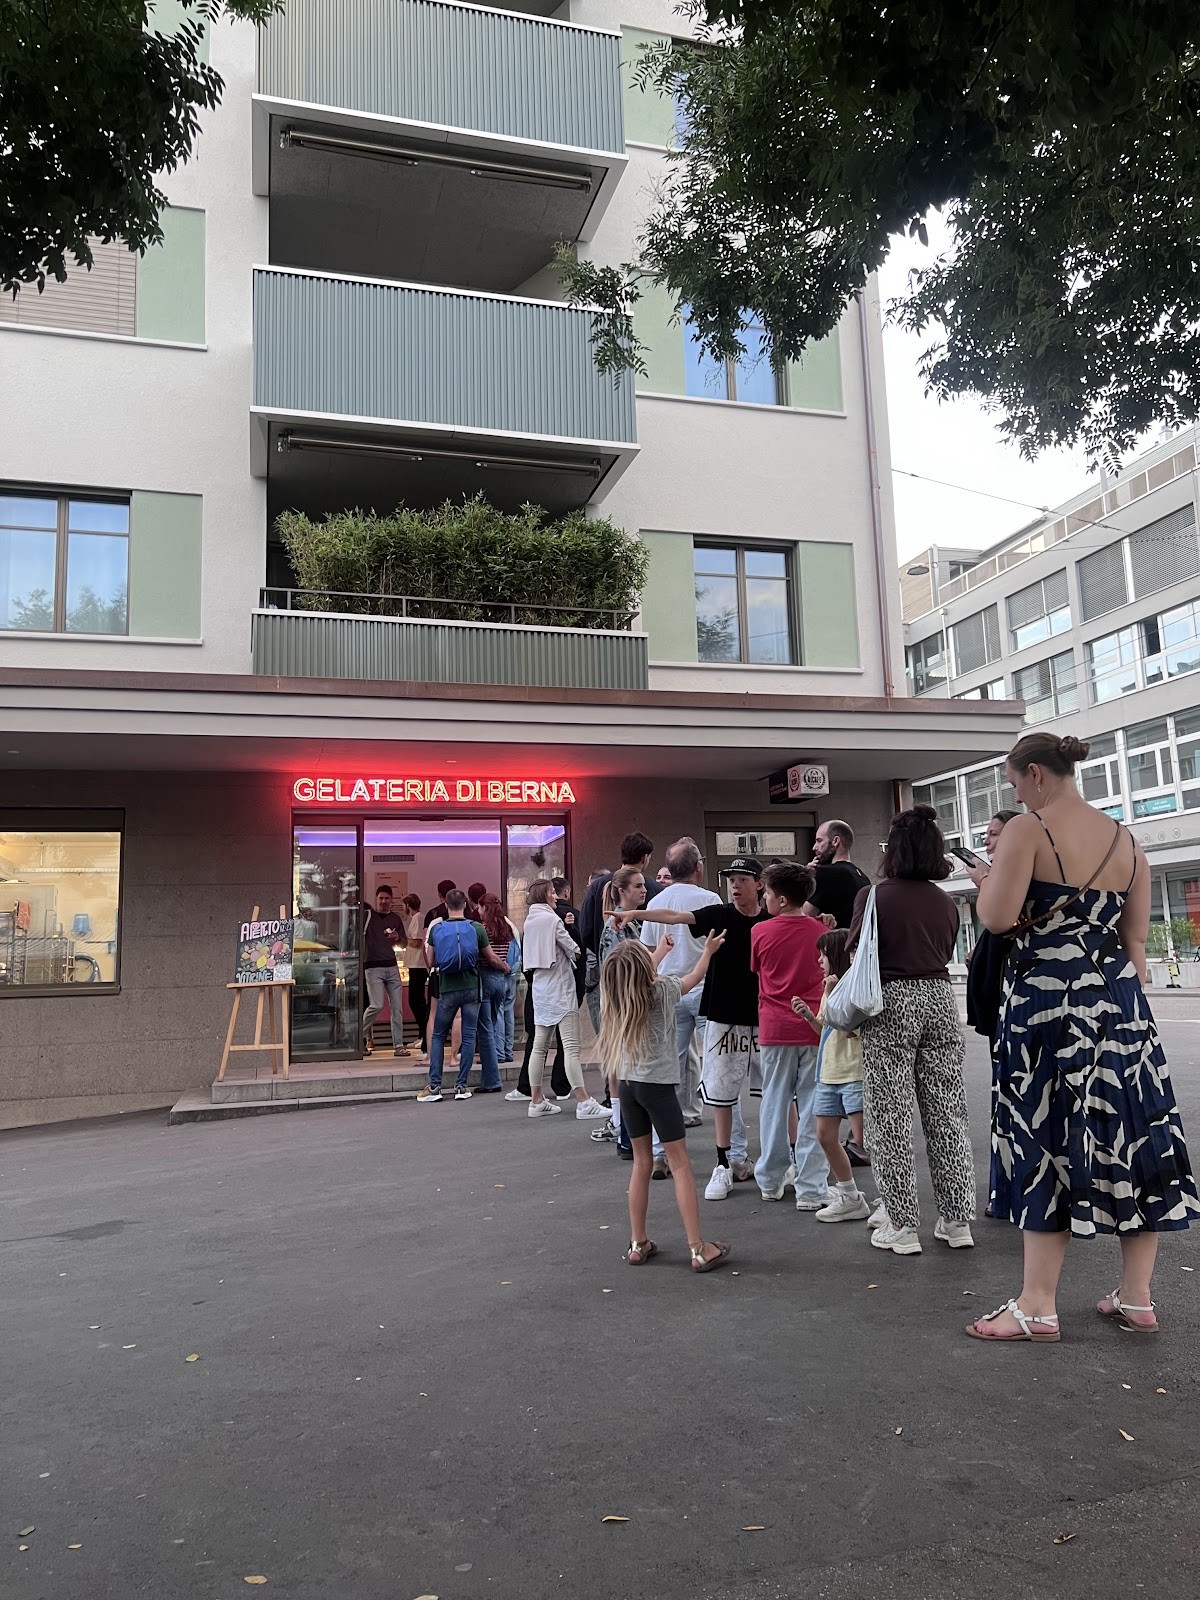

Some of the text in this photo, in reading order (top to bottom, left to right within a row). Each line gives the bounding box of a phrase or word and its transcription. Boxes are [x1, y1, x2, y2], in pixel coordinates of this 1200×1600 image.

[293, 777, 576, 803] GELATERIA DI BERNA
[240, 920, 280, 942] APERTO
